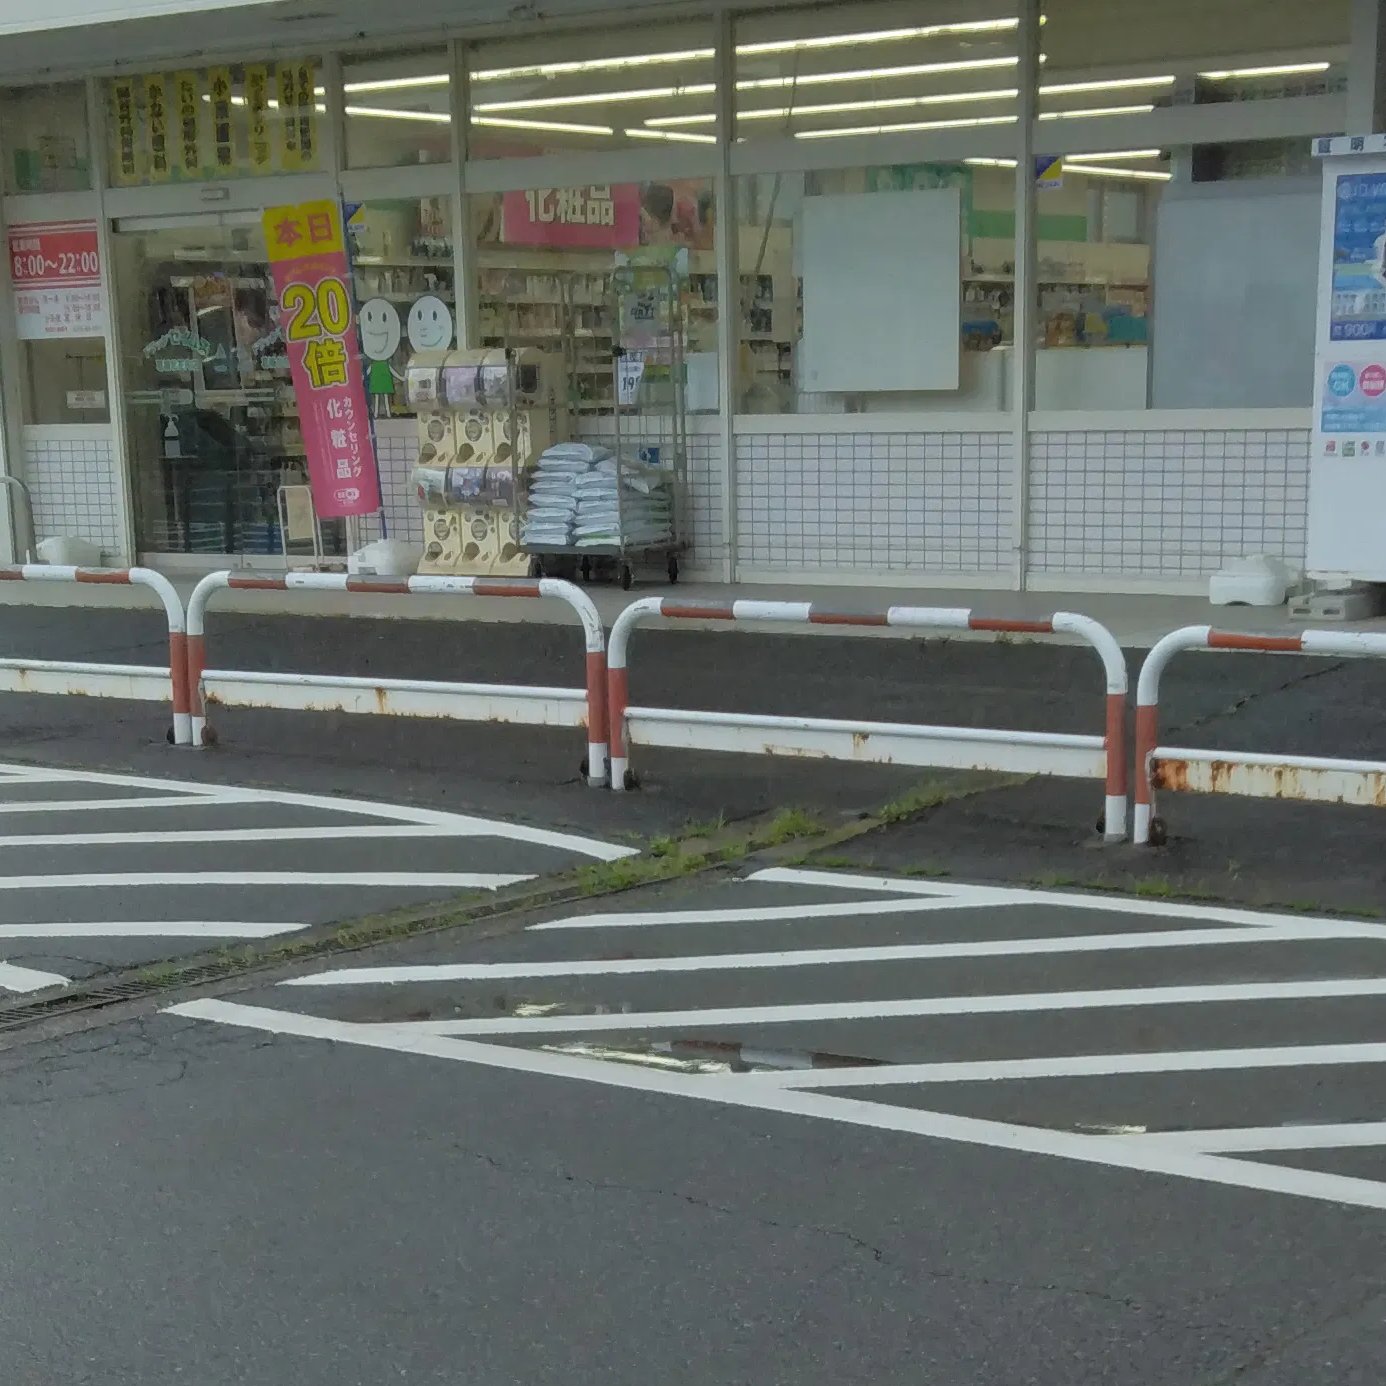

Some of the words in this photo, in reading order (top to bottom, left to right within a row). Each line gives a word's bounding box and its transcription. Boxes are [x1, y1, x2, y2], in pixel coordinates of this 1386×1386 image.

[274, 212, 334, 248] 本日
[282, 276, 352, 343] 20
[301, 337, 350, 391] 倍
[327, 398, 352, 479] 化粧品
[343, 396, 362, 478] カウンセリング
